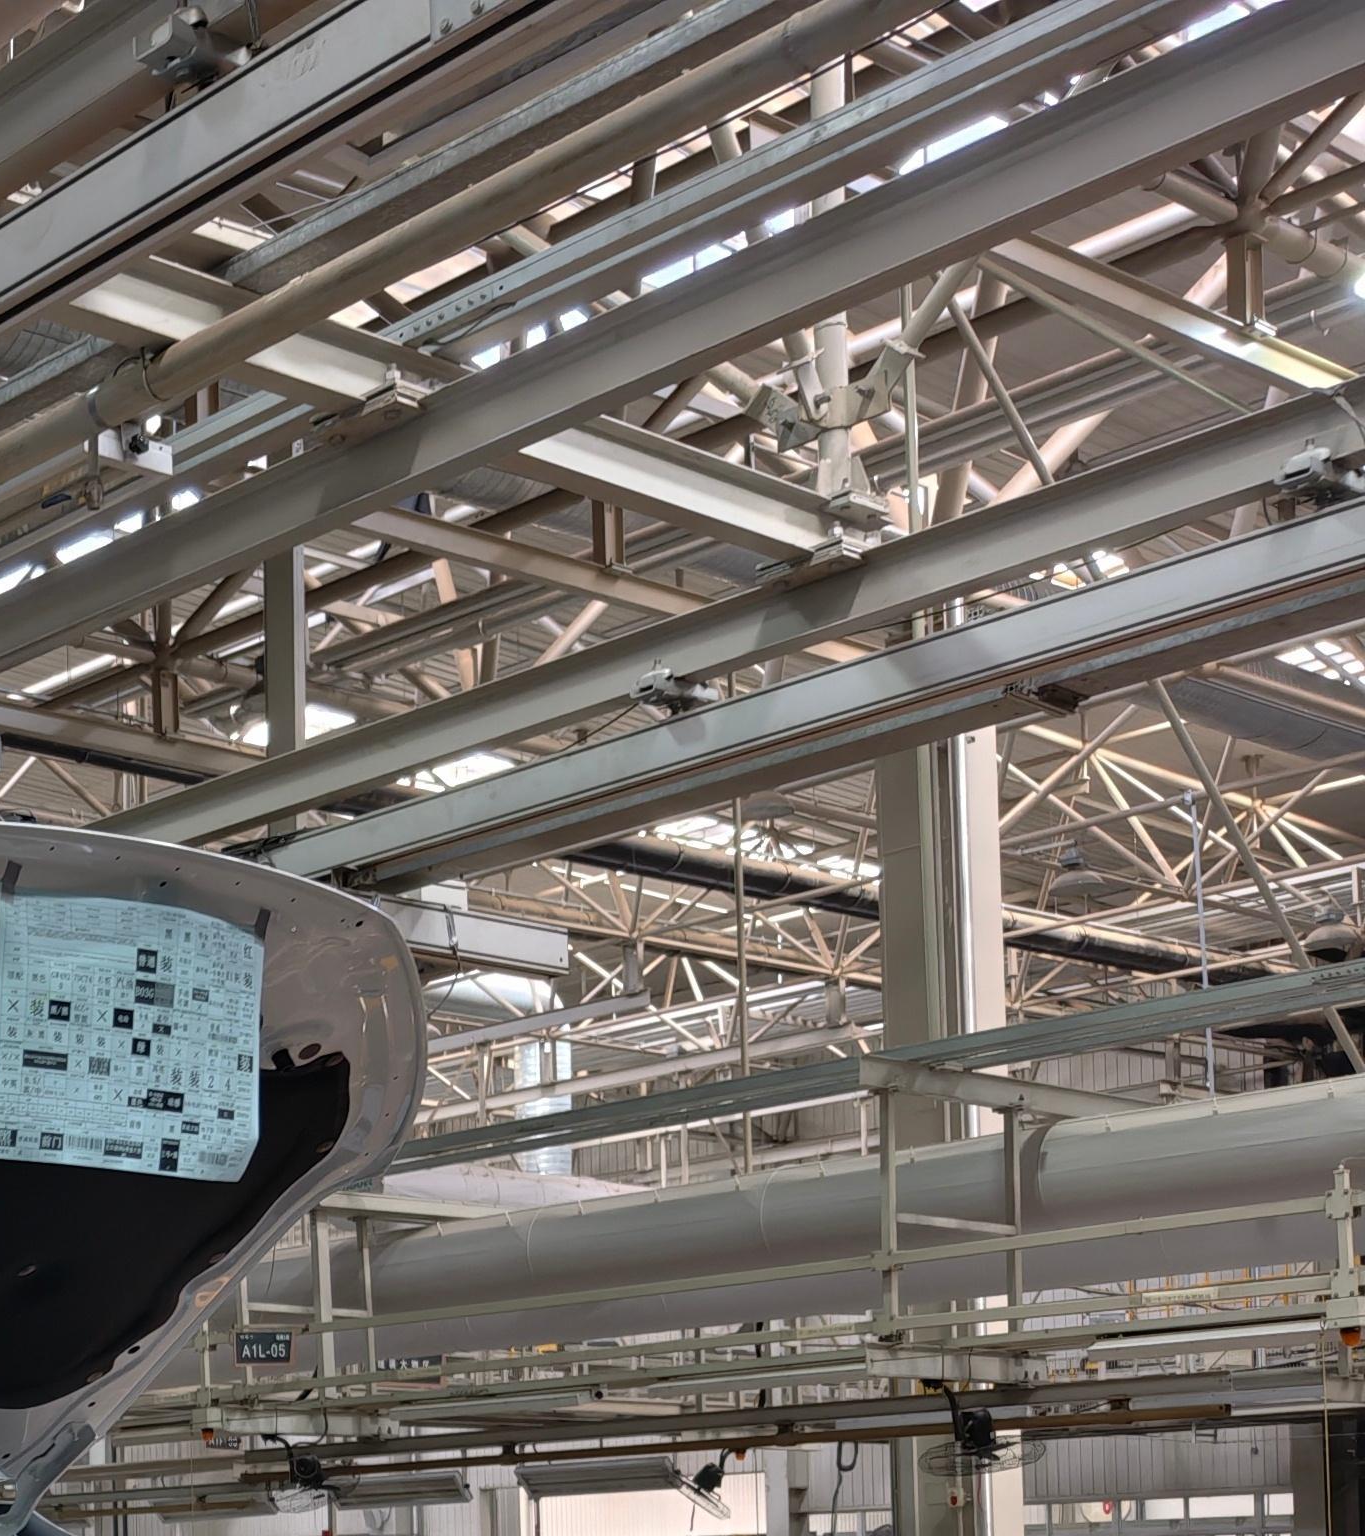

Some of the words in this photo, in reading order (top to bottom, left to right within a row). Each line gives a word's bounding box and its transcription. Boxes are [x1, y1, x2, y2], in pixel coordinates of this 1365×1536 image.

[207, 1075, 214, 1088] 2
[225, 1078, 231, 1091] 4
[241, 1343, 286, 1359] A1L-05
